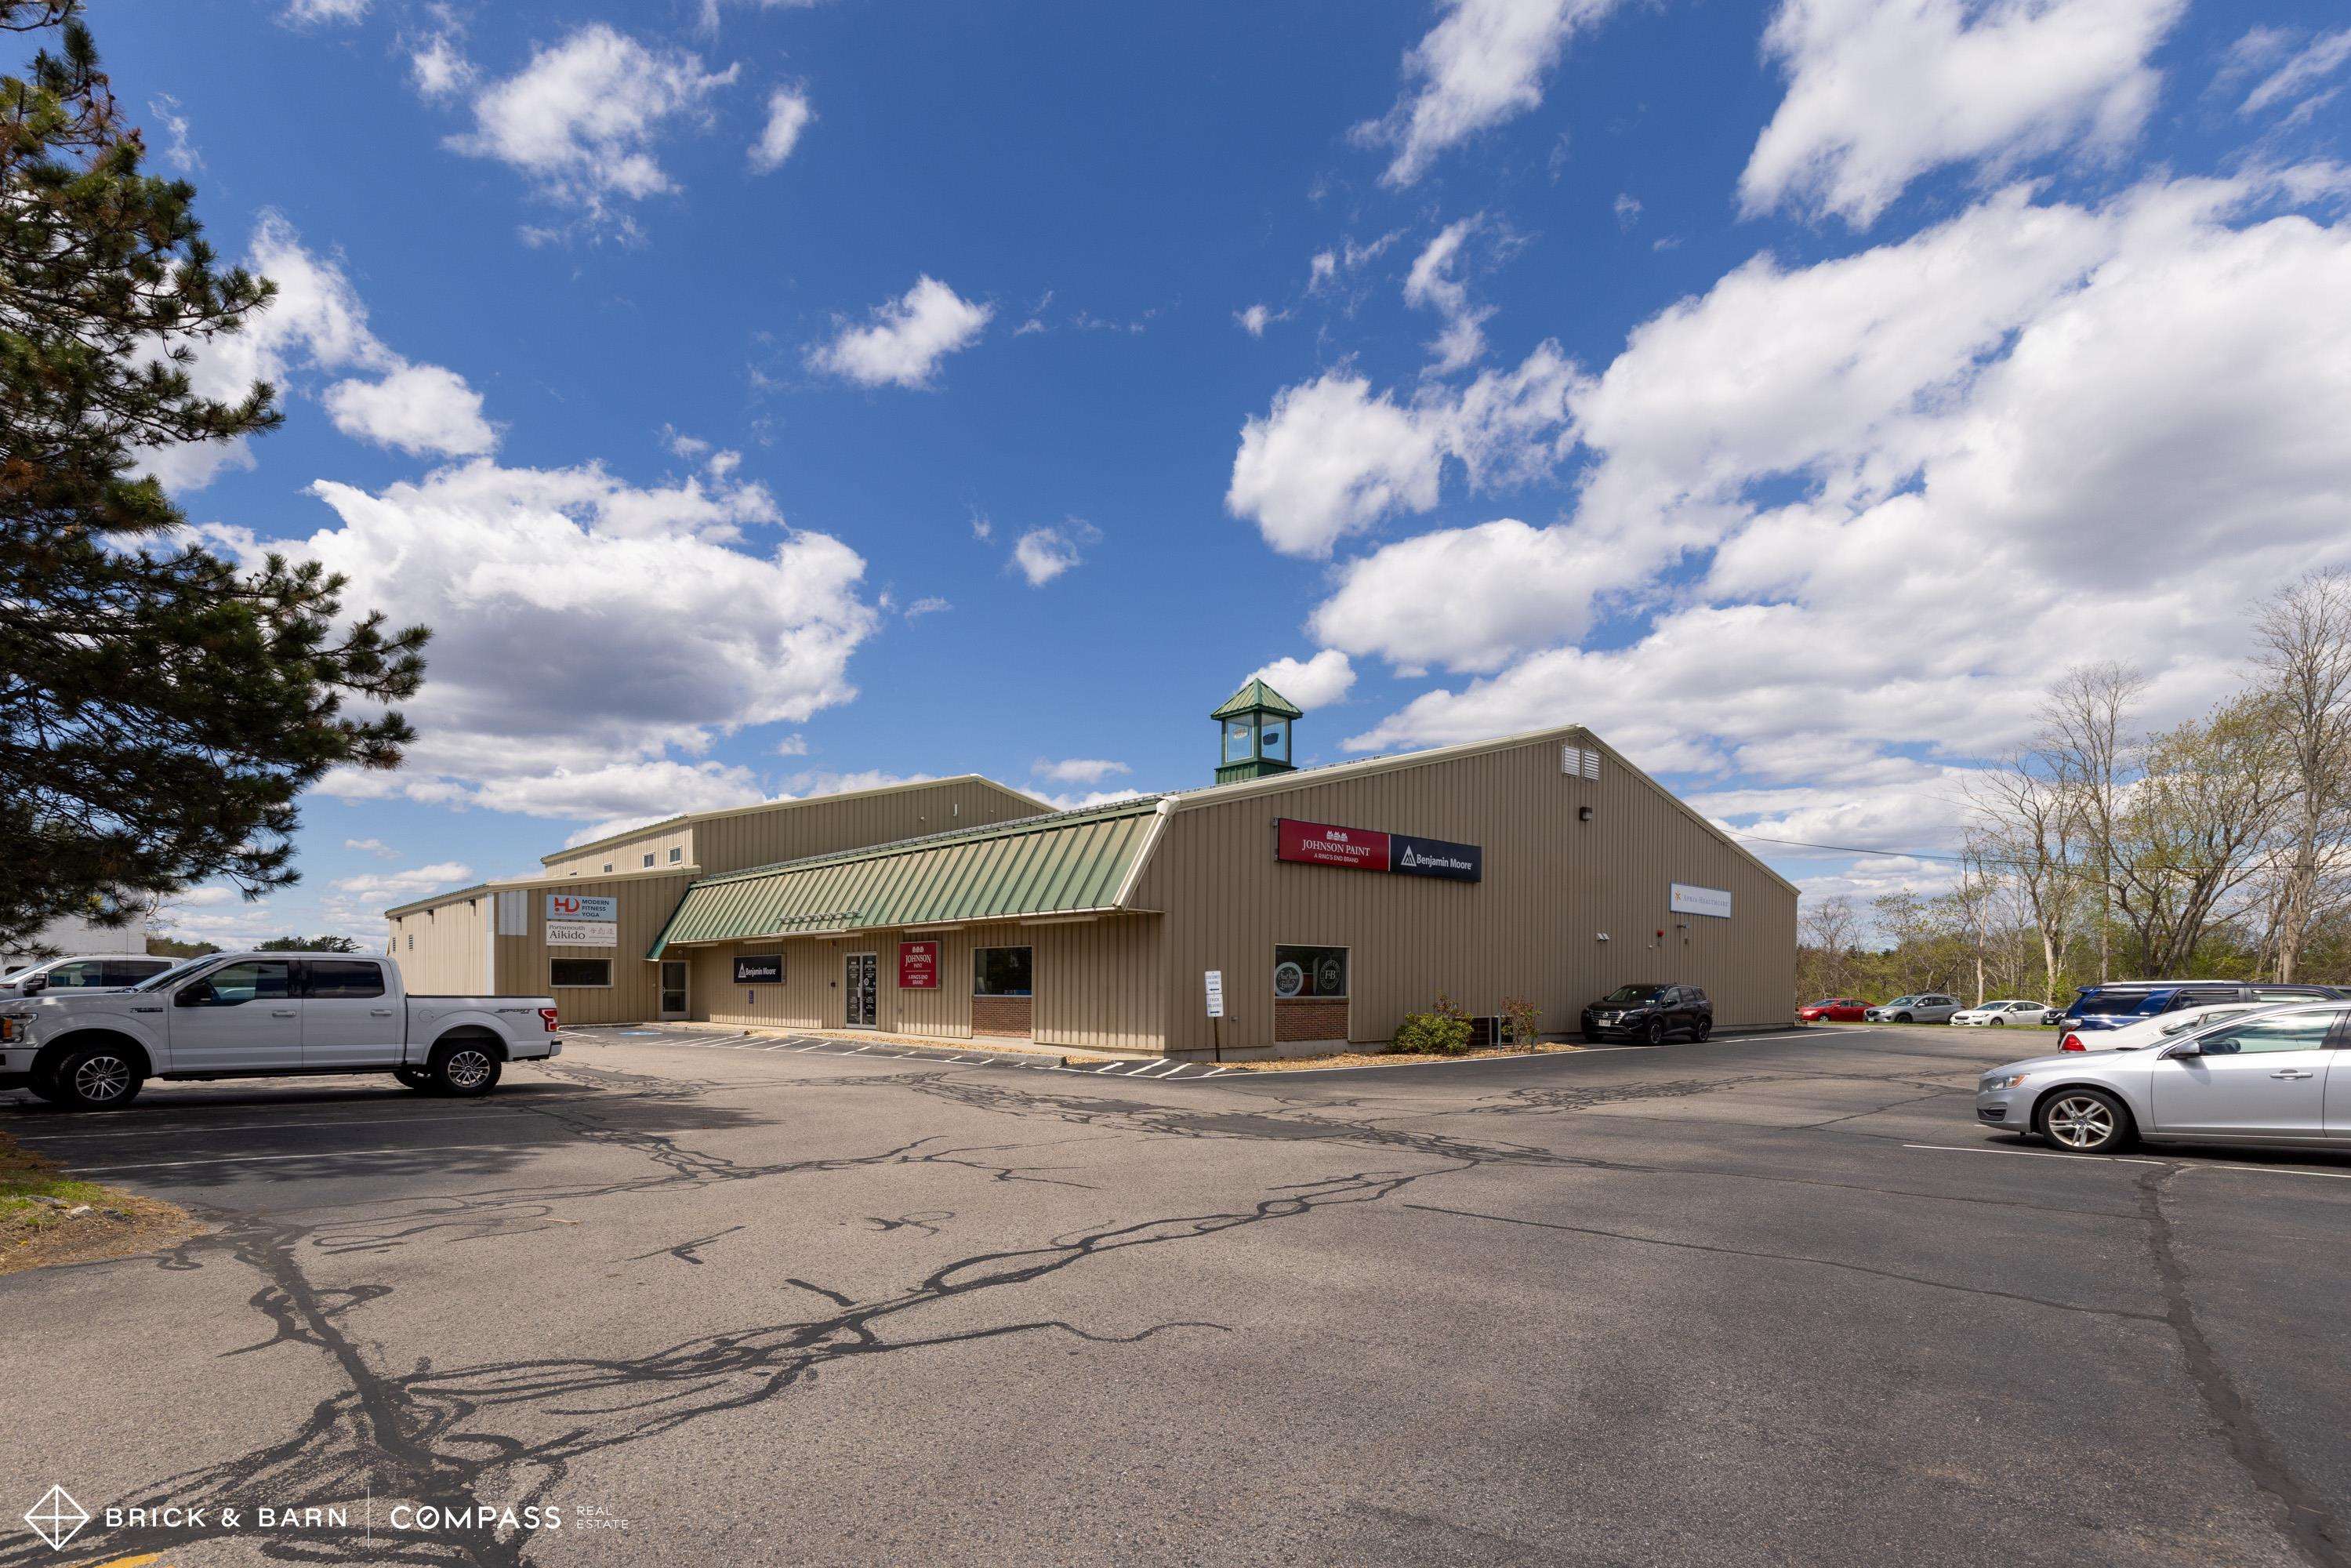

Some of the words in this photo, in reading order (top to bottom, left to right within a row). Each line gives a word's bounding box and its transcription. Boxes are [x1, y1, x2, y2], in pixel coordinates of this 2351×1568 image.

[1302, 839, 1344, 853] JOHNSON
[1345, 845, 1370, 856] PAINT
[1417, 854, 1449, 867] Benjamin
[549, 930, 586, 940] Aikido
[905, 954, 931, 967] JOHNSON
[746, 967, 763, 977] Benjamin
